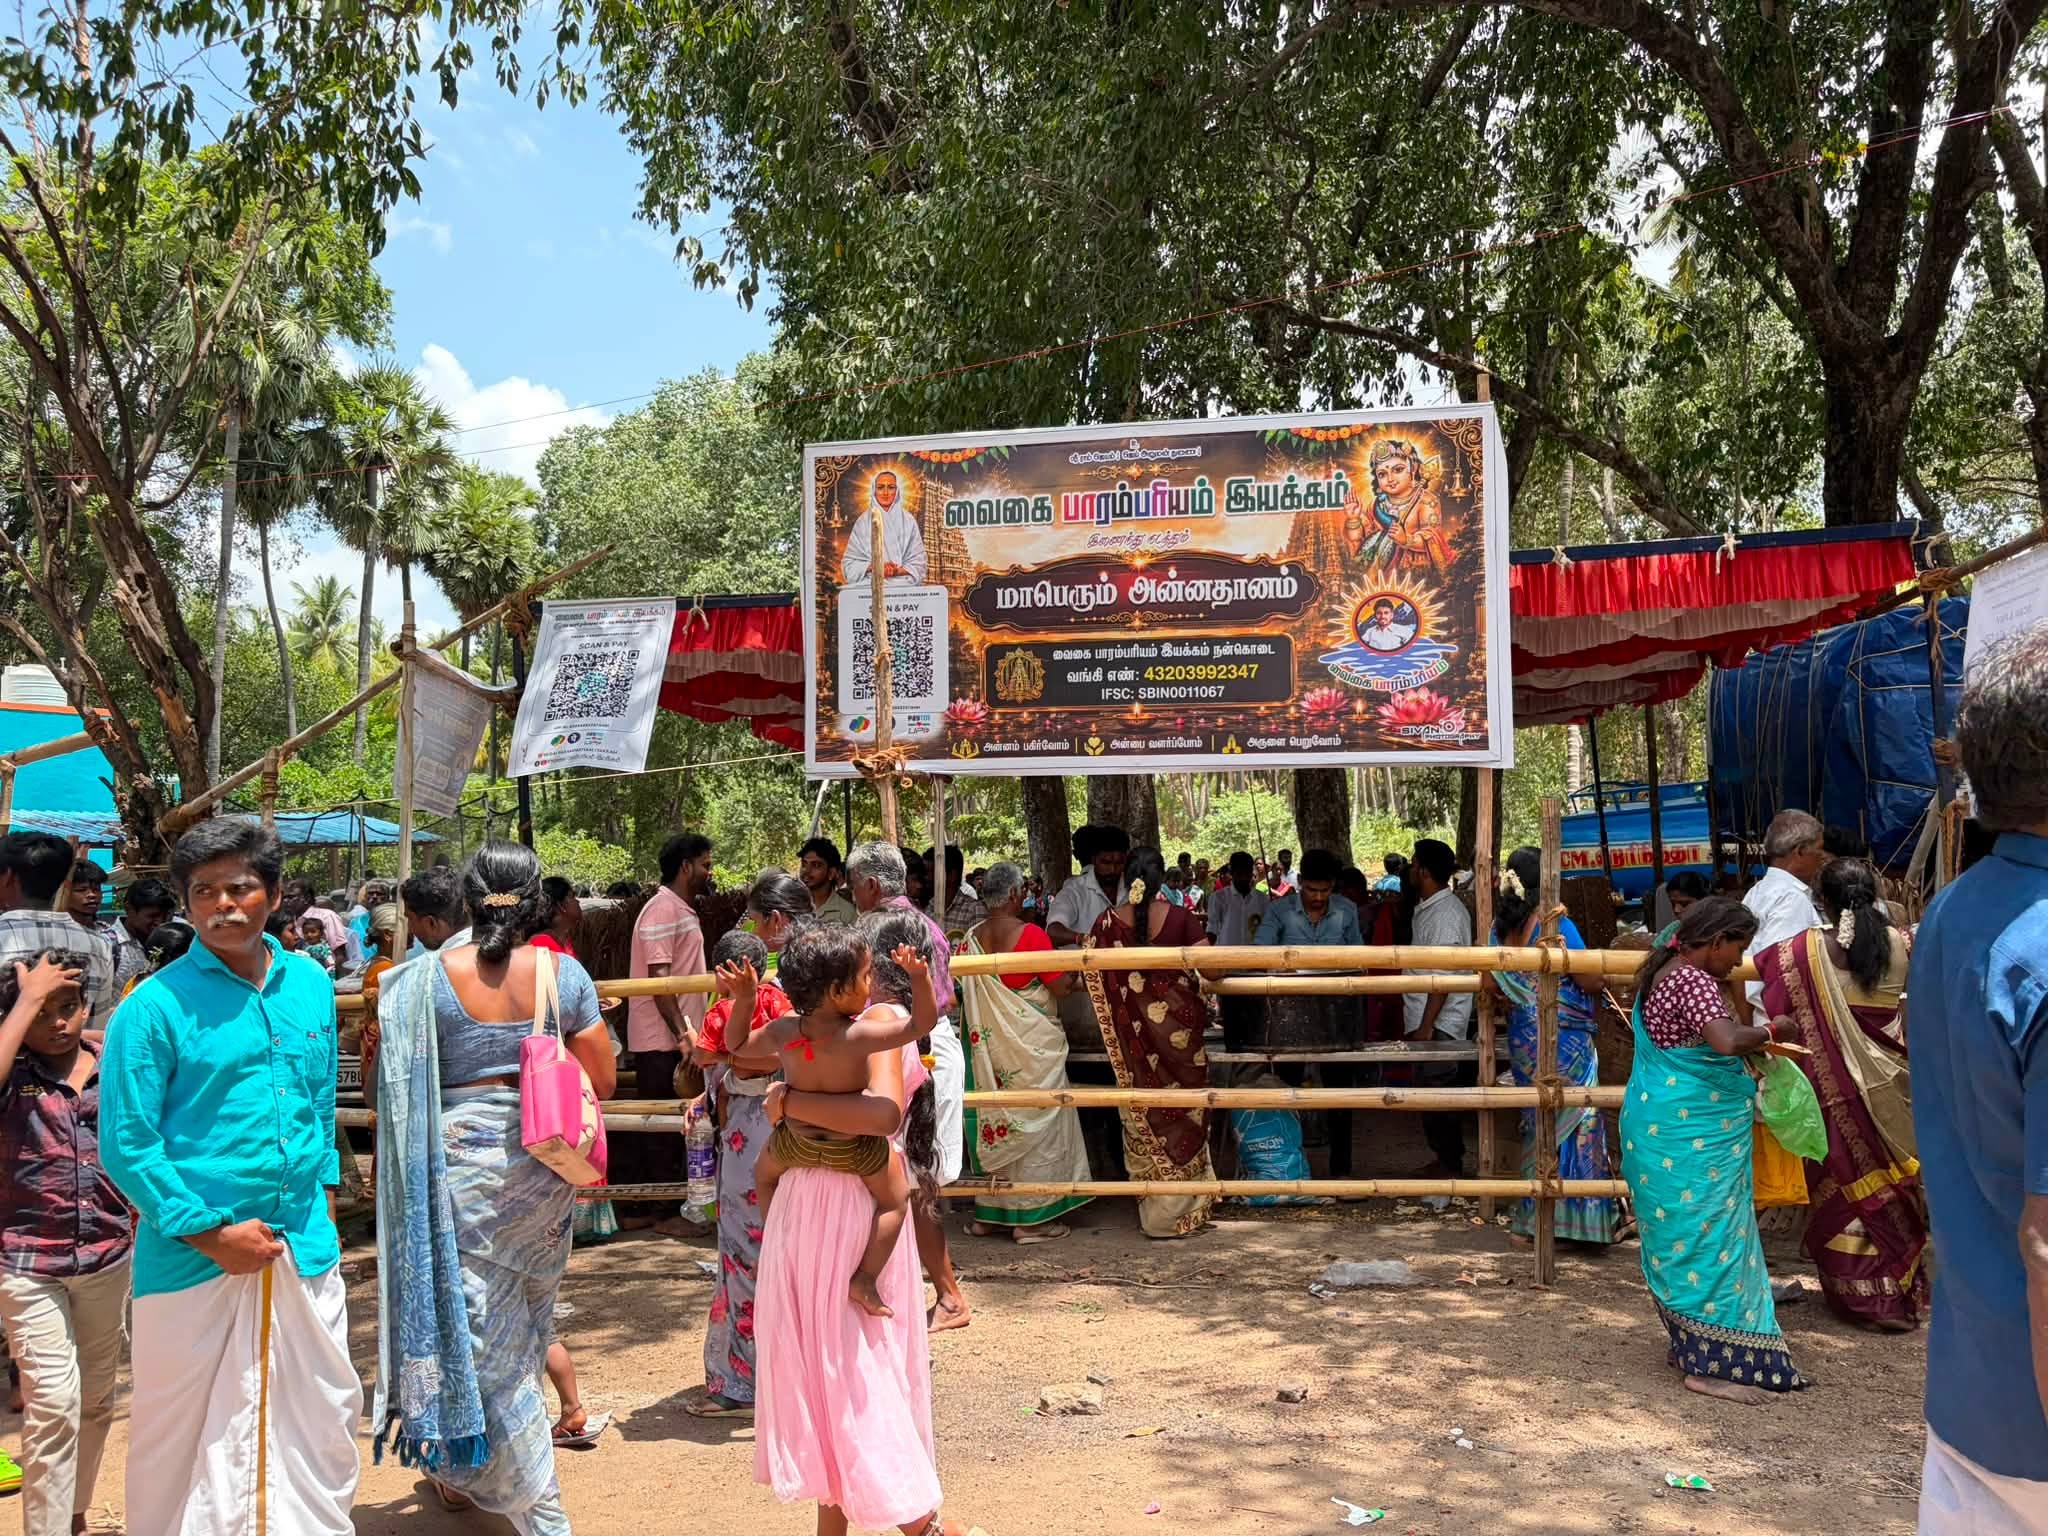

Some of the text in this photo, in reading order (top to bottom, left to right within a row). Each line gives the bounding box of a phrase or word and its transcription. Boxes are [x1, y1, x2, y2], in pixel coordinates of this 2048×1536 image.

[945, 472, 1349, 527] வைகை பாரம்பரியம் இயக்கம்
[996, 565, 1297, 612] மாபெரும் அன்னதானம்
[903, 604, 920, 612] PAY
[578, 642, 602, 650] SCAN
[1052, 642, 1276, 662] வைகை பாரம்பரியம் இயக்கம் நன்கொடை
[1067, 664, 1259, 683] வங்கி எண்: 43203992347
[1101, 685, 1225, 700] IFSC: SBIN0011067
[983, 734, 1342, 752] அன்னம் பகிர்வோம் அன்பை வளர்ப்போம் அருளை பெறுவோம்
